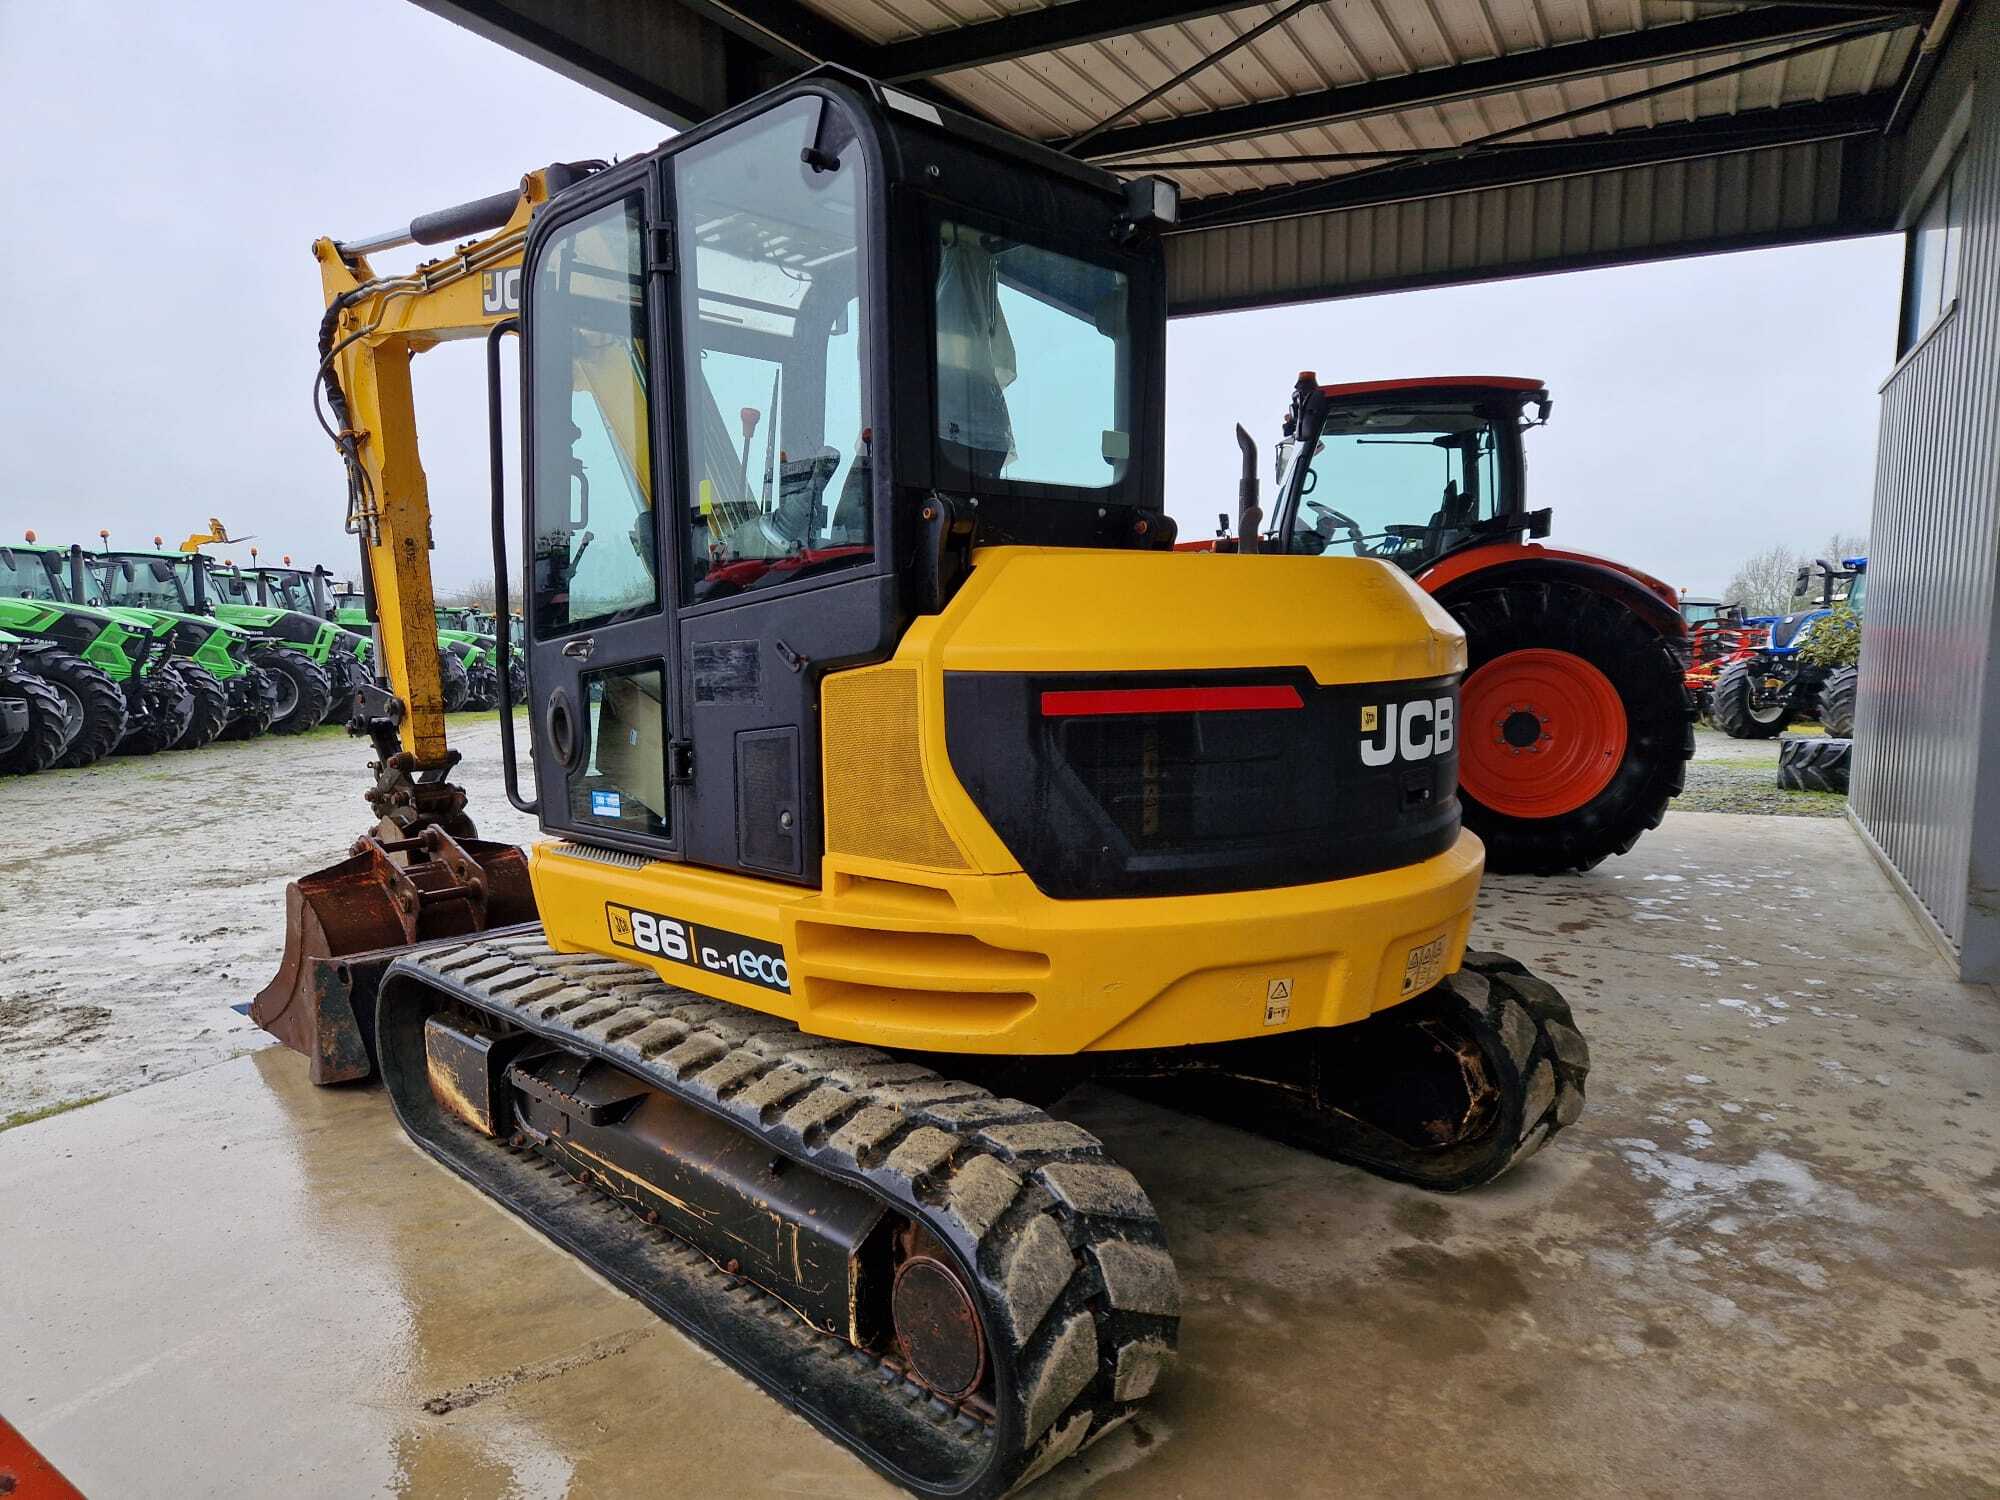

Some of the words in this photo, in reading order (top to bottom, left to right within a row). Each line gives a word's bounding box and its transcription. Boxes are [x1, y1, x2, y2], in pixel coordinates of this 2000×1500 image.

[484, 268, 521, 312] JC
[1360, 697, 1454, 767] JCB
[630, 911, 689, 960] 86
